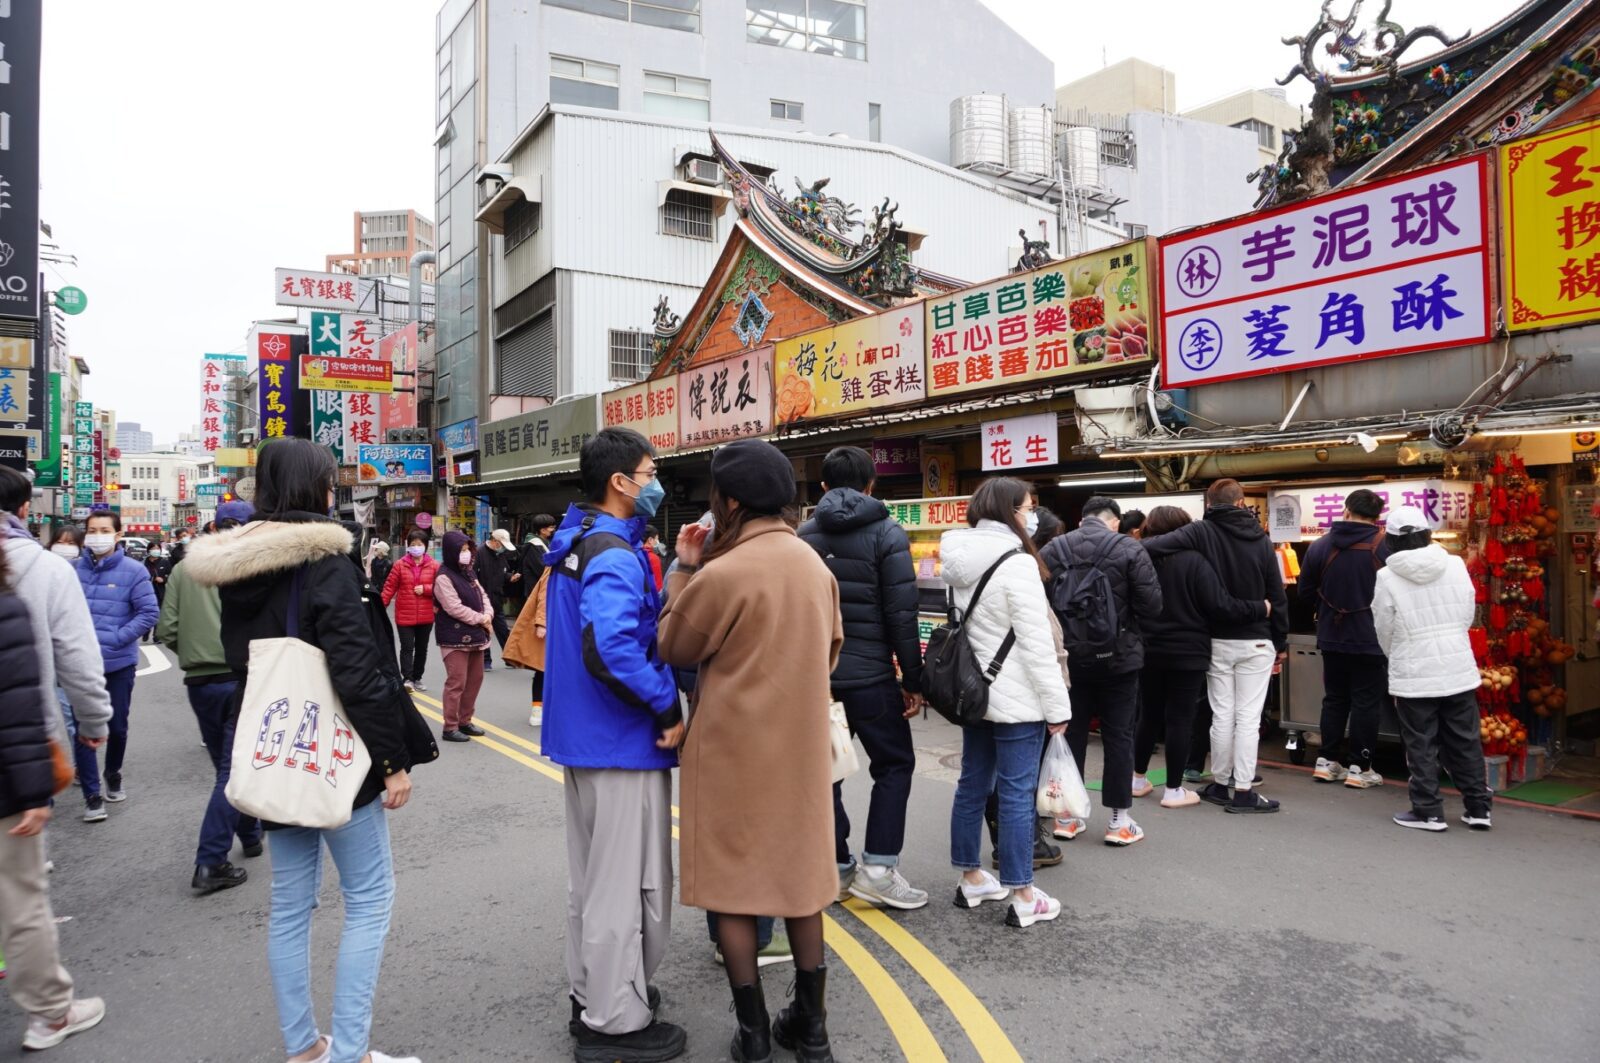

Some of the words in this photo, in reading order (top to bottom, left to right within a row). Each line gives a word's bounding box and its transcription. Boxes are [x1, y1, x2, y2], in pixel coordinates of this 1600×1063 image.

[1545, 145, 1600, 198] 王
[1184, 253, 1217, 290] 林
[1241, 181, 1460, 283] 芋泥球
[282, 276, 356, 303] 元寶銀樓
[931, 271, 1066, 329] 甘草芭樂
[932, 305, 1067, 359] 紅心芭樂
[1187, 326, 1214, 365] 李
[1243, 273, 1464, 361] 菱角酥
[316, 316, 344, 449] 大眼鏡
[795, 341, 843, 382] 梅花
[841, 363, 922, 405] 雞蛋糕
[933, 339, 1069, 390] 蜜餞蕃茄
[484, 419, 549, 458] 賢隆百貨行
[988, 424, 1005, 436] 水煮
[990, 434, 1049, 467] 花生
[252, 698, 355, 787] GAP
